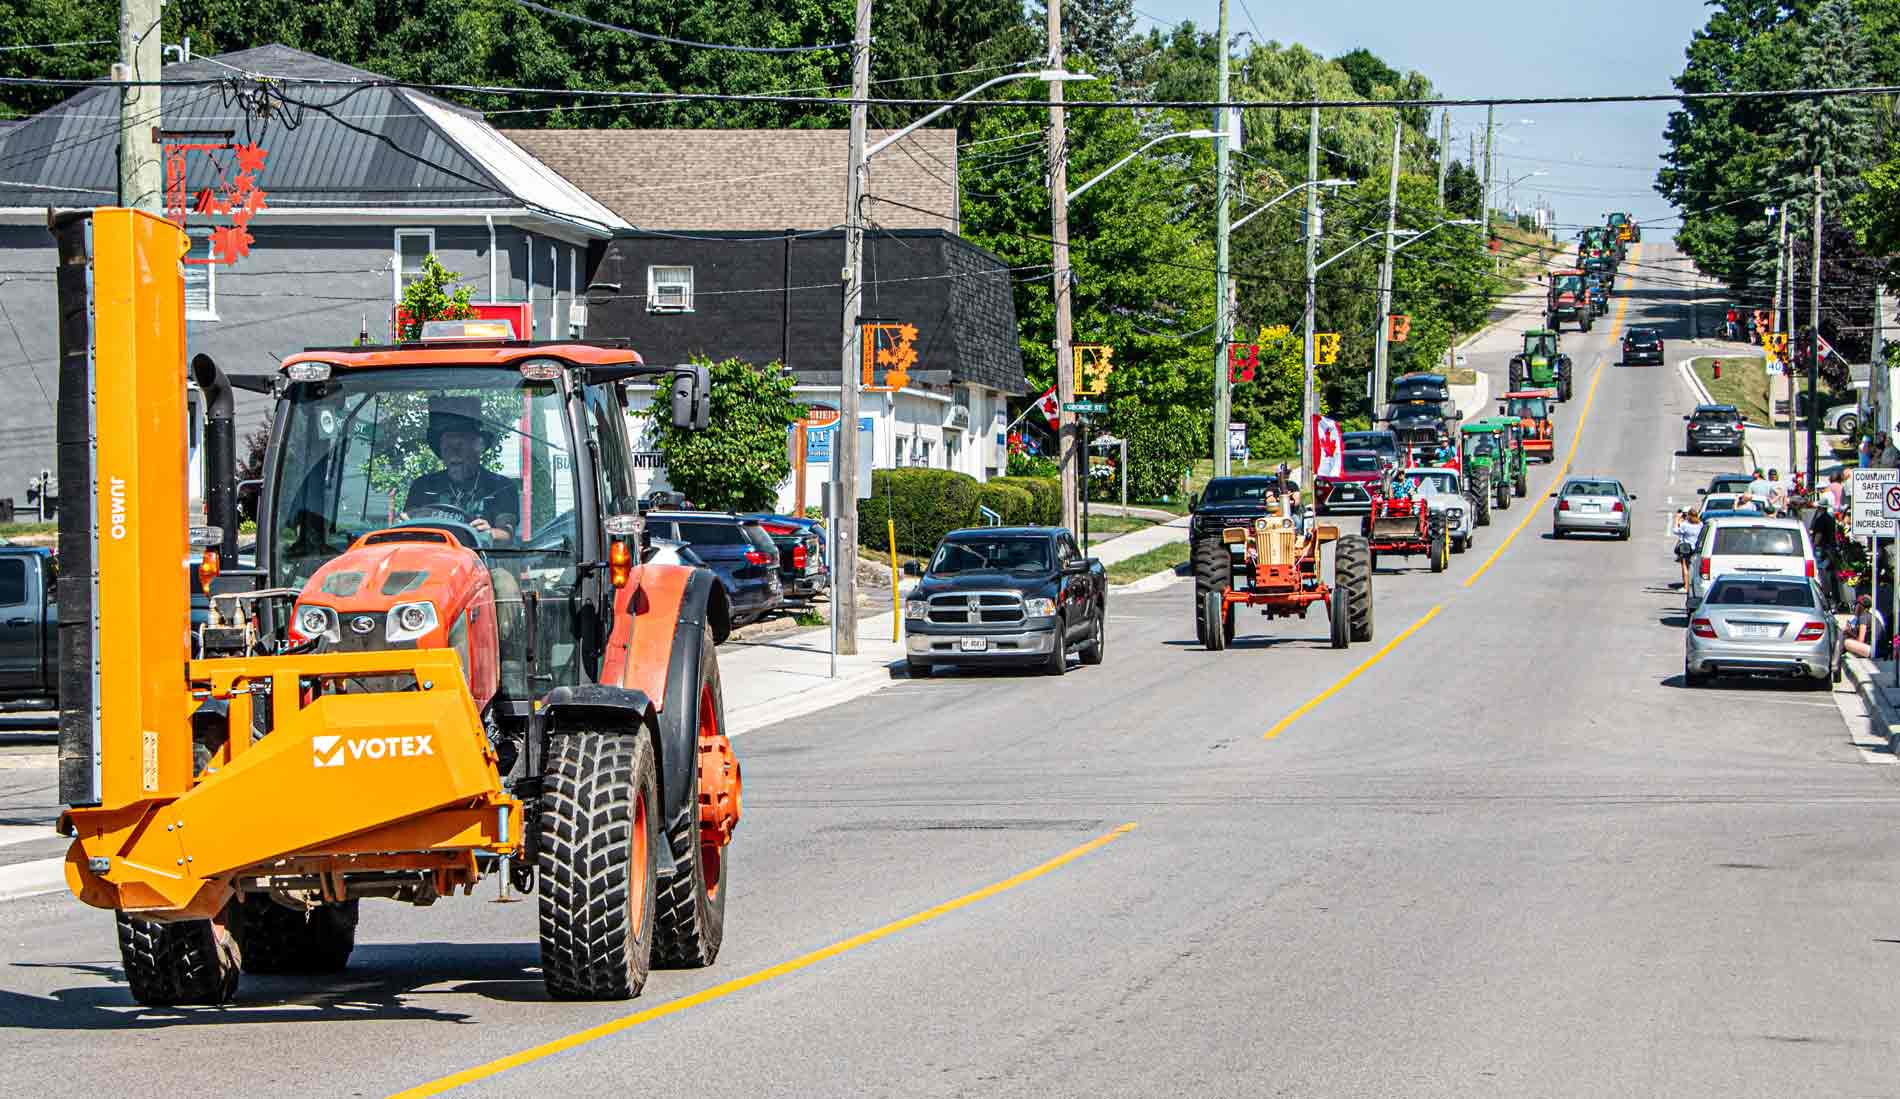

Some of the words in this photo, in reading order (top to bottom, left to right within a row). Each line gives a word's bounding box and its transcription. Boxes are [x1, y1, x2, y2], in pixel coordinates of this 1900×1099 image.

[1855, 472, 1896, 481] COMMUNITY
[111, 475, 126, 540] JUMBO
[1855, 520, 1894, 528] INCREASED
[346, 735, 434, 760] VOTEX
